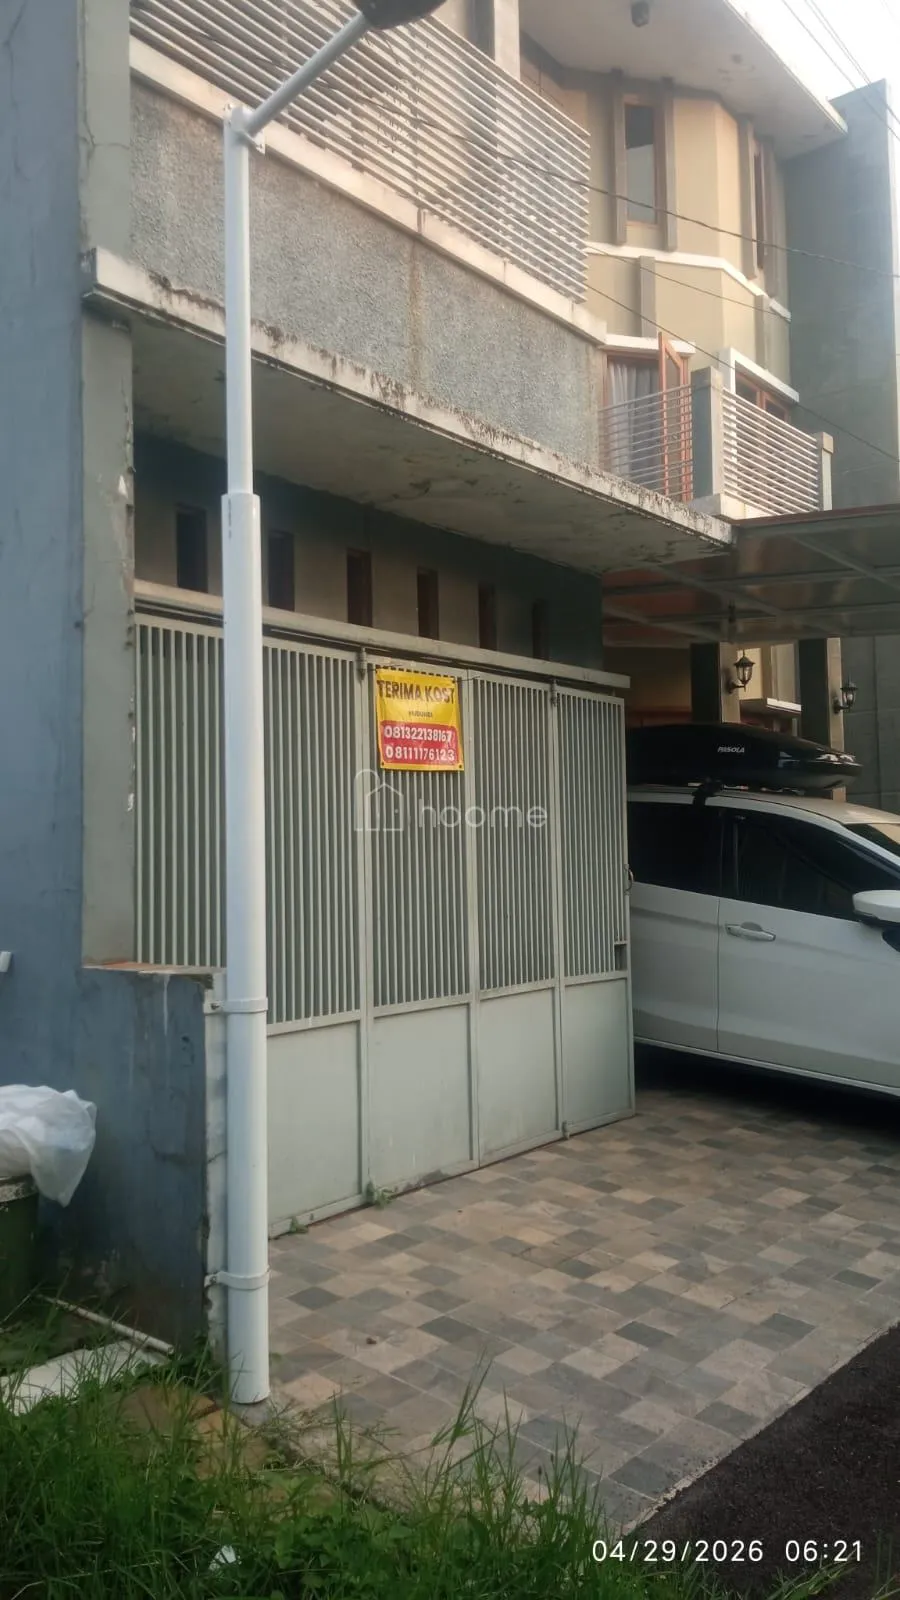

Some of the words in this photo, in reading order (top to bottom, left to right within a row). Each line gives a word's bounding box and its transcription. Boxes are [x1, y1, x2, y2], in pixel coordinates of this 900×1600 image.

[377, 680, 422, 701] TERIMA
[424, 685, 455, 705] KOST
[385, 745, 456, 762] 08111176123
